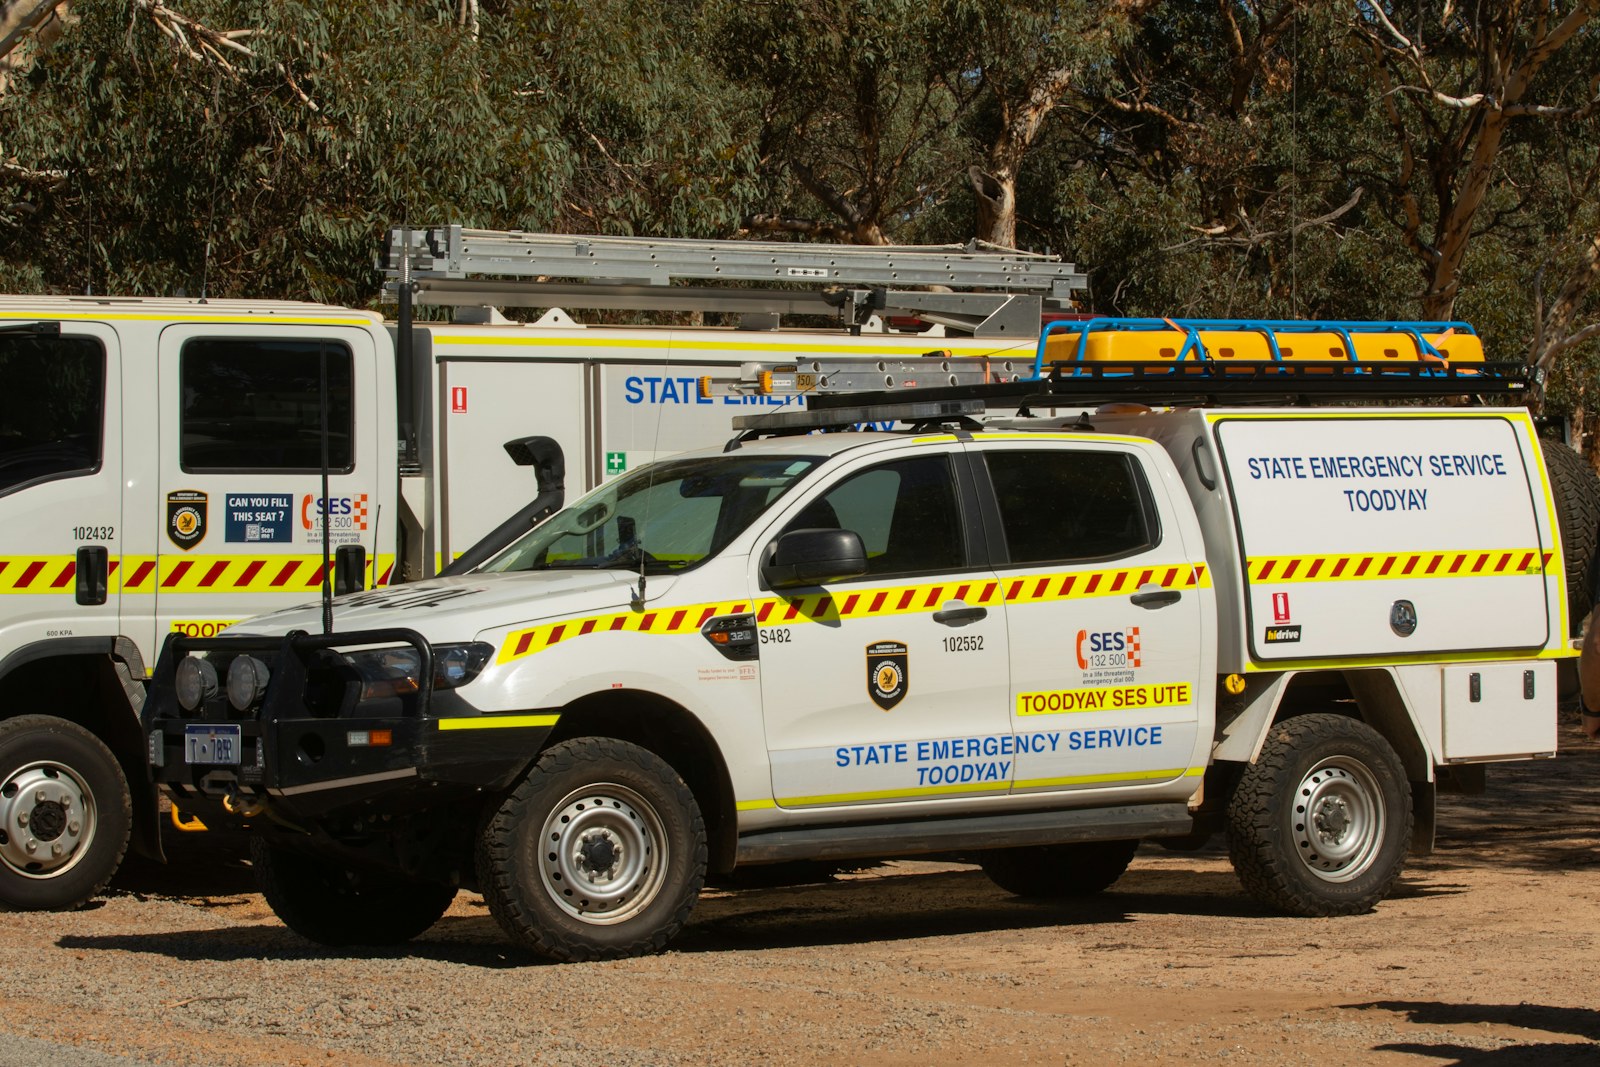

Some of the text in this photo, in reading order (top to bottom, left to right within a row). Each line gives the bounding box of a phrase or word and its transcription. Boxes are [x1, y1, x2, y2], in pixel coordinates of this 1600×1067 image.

[1248, 454, 1507, 479] STATE EMERGENCY SERVICE
[229, 498, 288, 507] CAN YOU FILL
[316, 498, 351, 514] SES
[1343, 489, 1428, 512] TOODYAY
[233, 511, 284, 521] THIS SEAT ?
[334, 517, 352, 528] 500
[73, 527, 114, 540] 102432
[760, 628, 791, 644] S482
[942, 635, 984, 652] 102552
[1090, 632, 1125, 652] SES
[1267, 630, 1299, 641] hidrive
[1090, 653, 1126, 666] 132 500
[1104, 670, 1134, 678] threatening
[1021, 685, 1187, 713] TOODYAY SES UTE
[836, 726, 1162, 767] STATE EMERGENCY SERVICE
[917, 761, 1011, 785] TOODYAY
